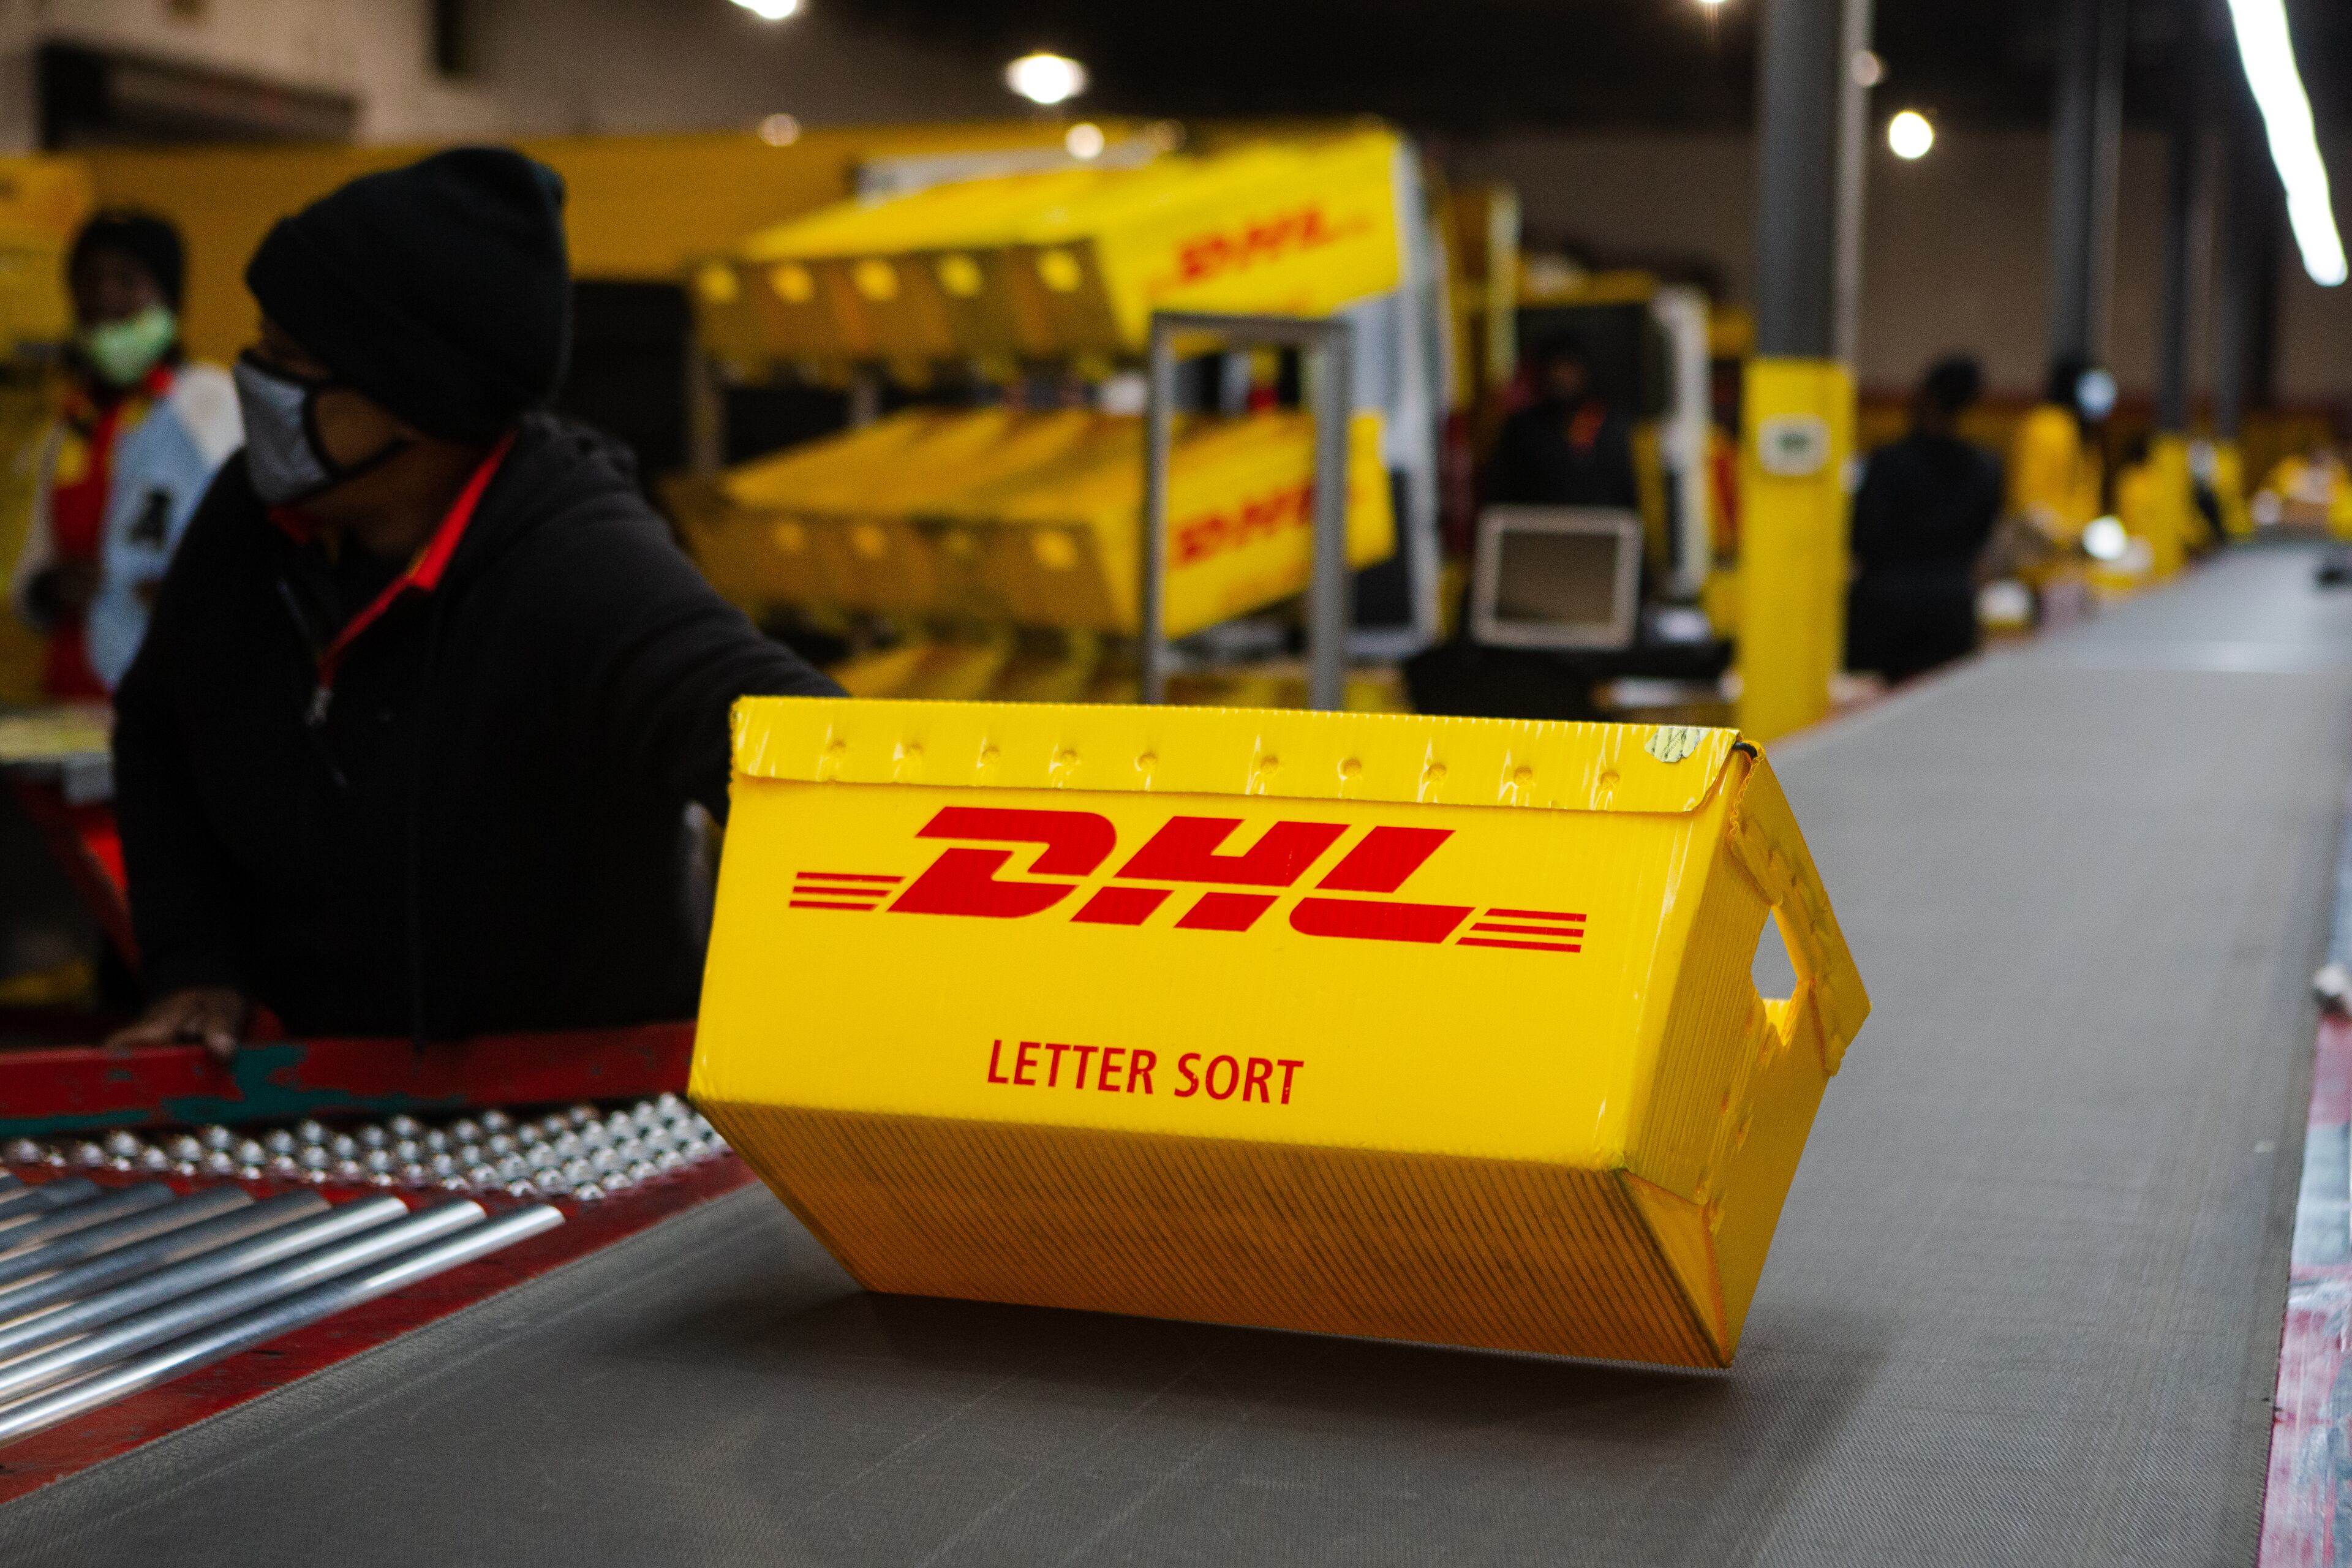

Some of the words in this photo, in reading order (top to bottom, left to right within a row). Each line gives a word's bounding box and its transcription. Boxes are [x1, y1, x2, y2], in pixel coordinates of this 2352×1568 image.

[886, 806, 1477, 944] DHL
[987, 1039, 1158, 1095] LETTER
[1174, 1052, 1305, 1105] SORT
